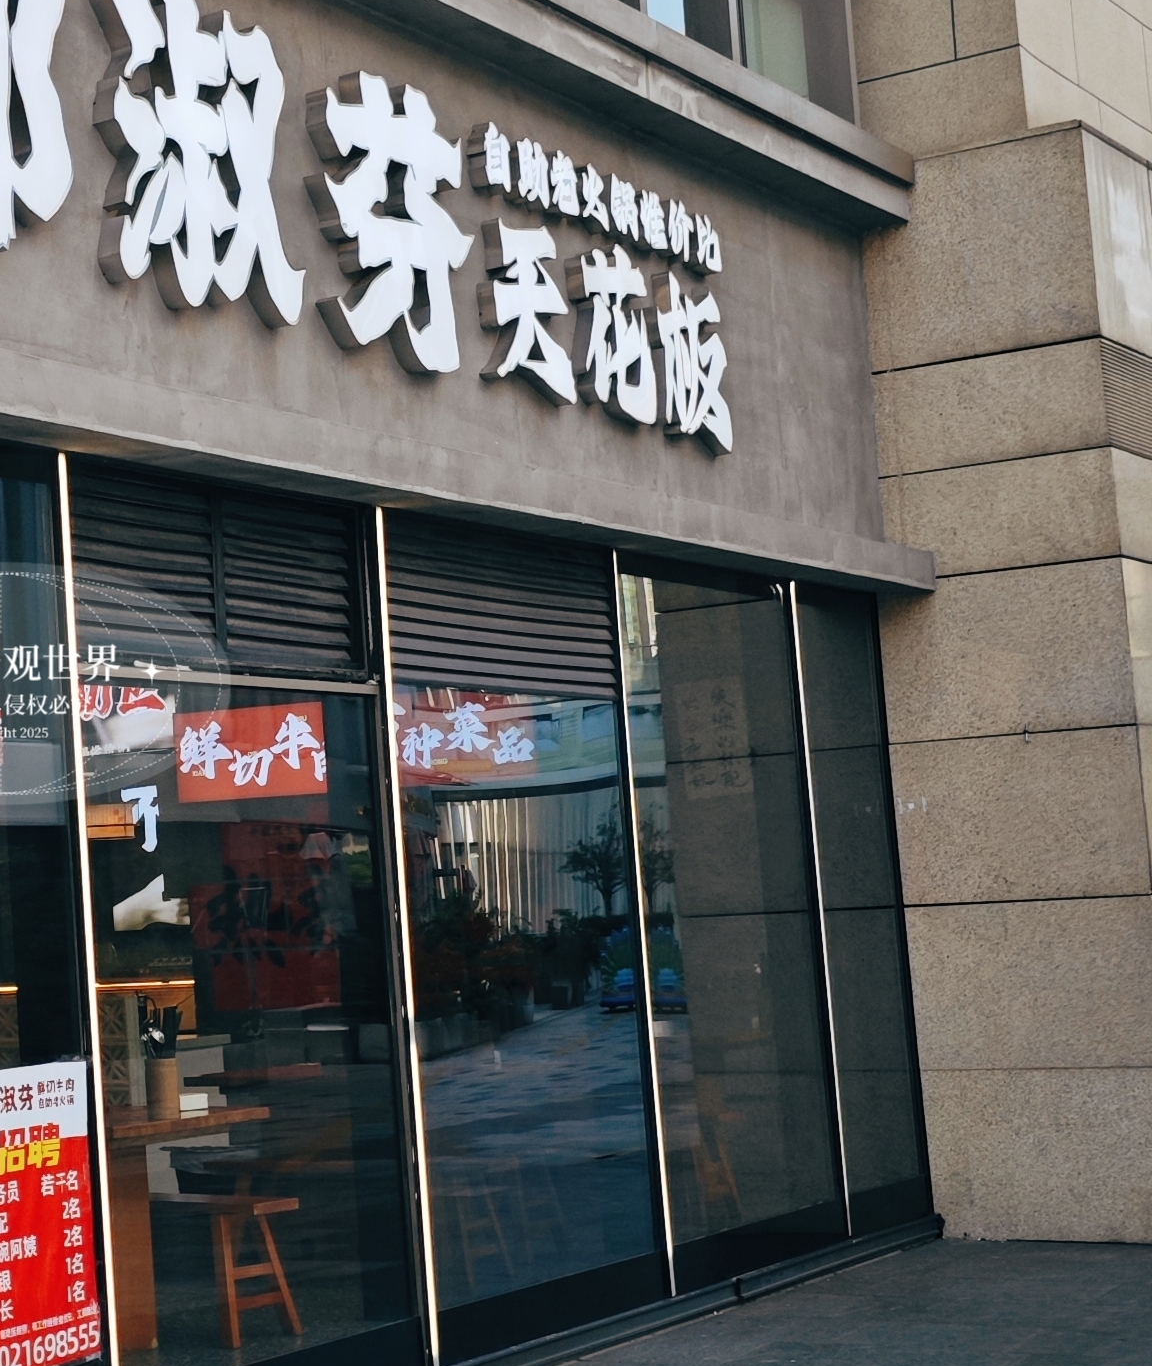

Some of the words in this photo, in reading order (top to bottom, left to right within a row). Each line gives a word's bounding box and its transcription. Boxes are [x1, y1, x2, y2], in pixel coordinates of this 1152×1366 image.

[491, 216, 734, 456] 天花板
[37, 1077, 75, 1096] 鲜切牛肉
[61, 1196, 81, 1220] 2名
[63, 1224, 83, 1248] 2名
[65, 1252, 84, 1275] 1名
